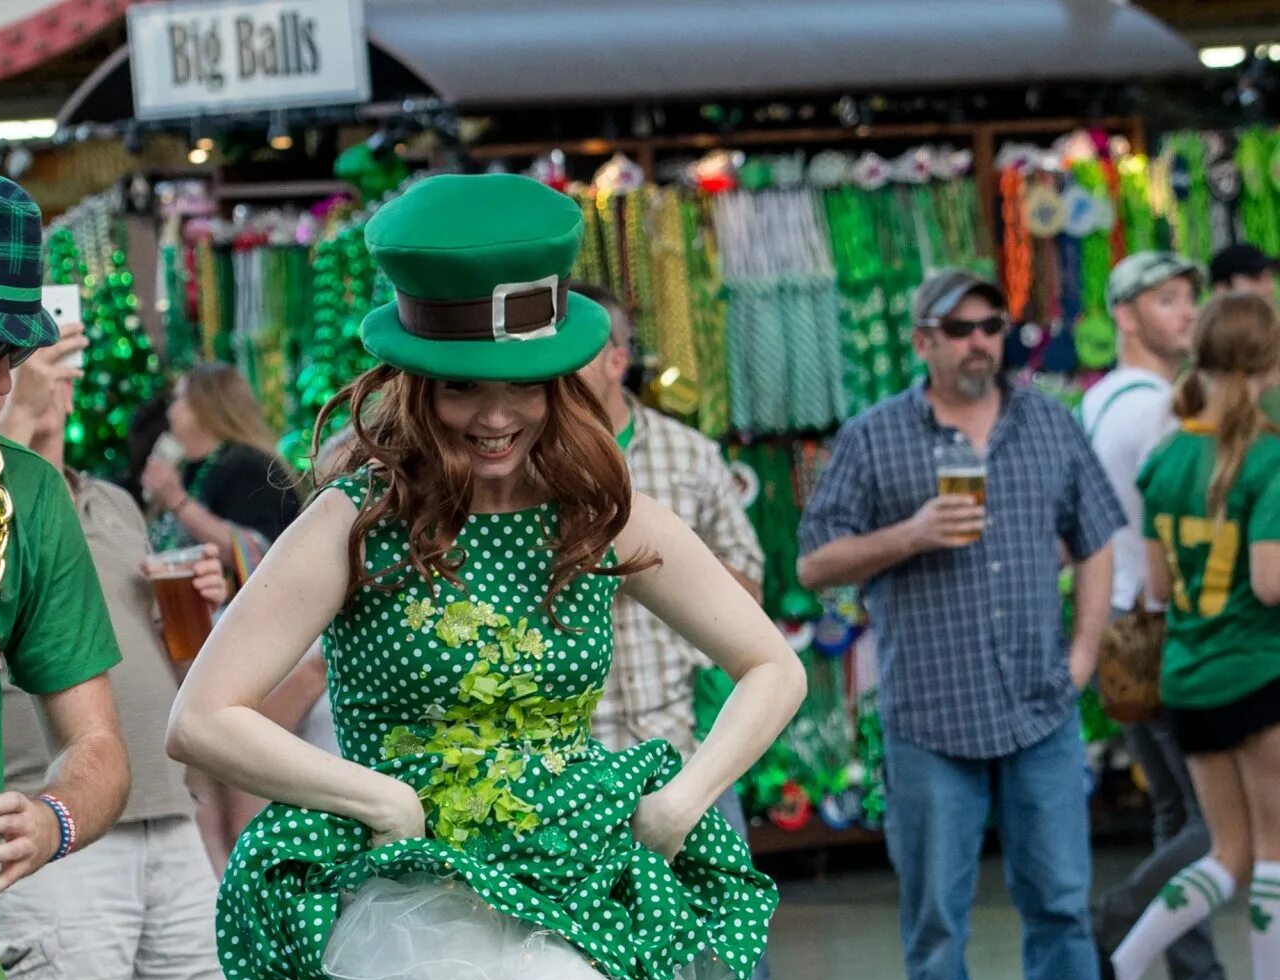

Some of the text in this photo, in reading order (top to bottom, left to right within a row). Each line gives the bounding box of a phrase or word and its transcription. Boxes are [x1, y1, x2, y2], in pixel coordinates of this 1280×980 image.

[168, 12, 320, 92] Big Balls
[1154, 513, 1240, 619] 17
